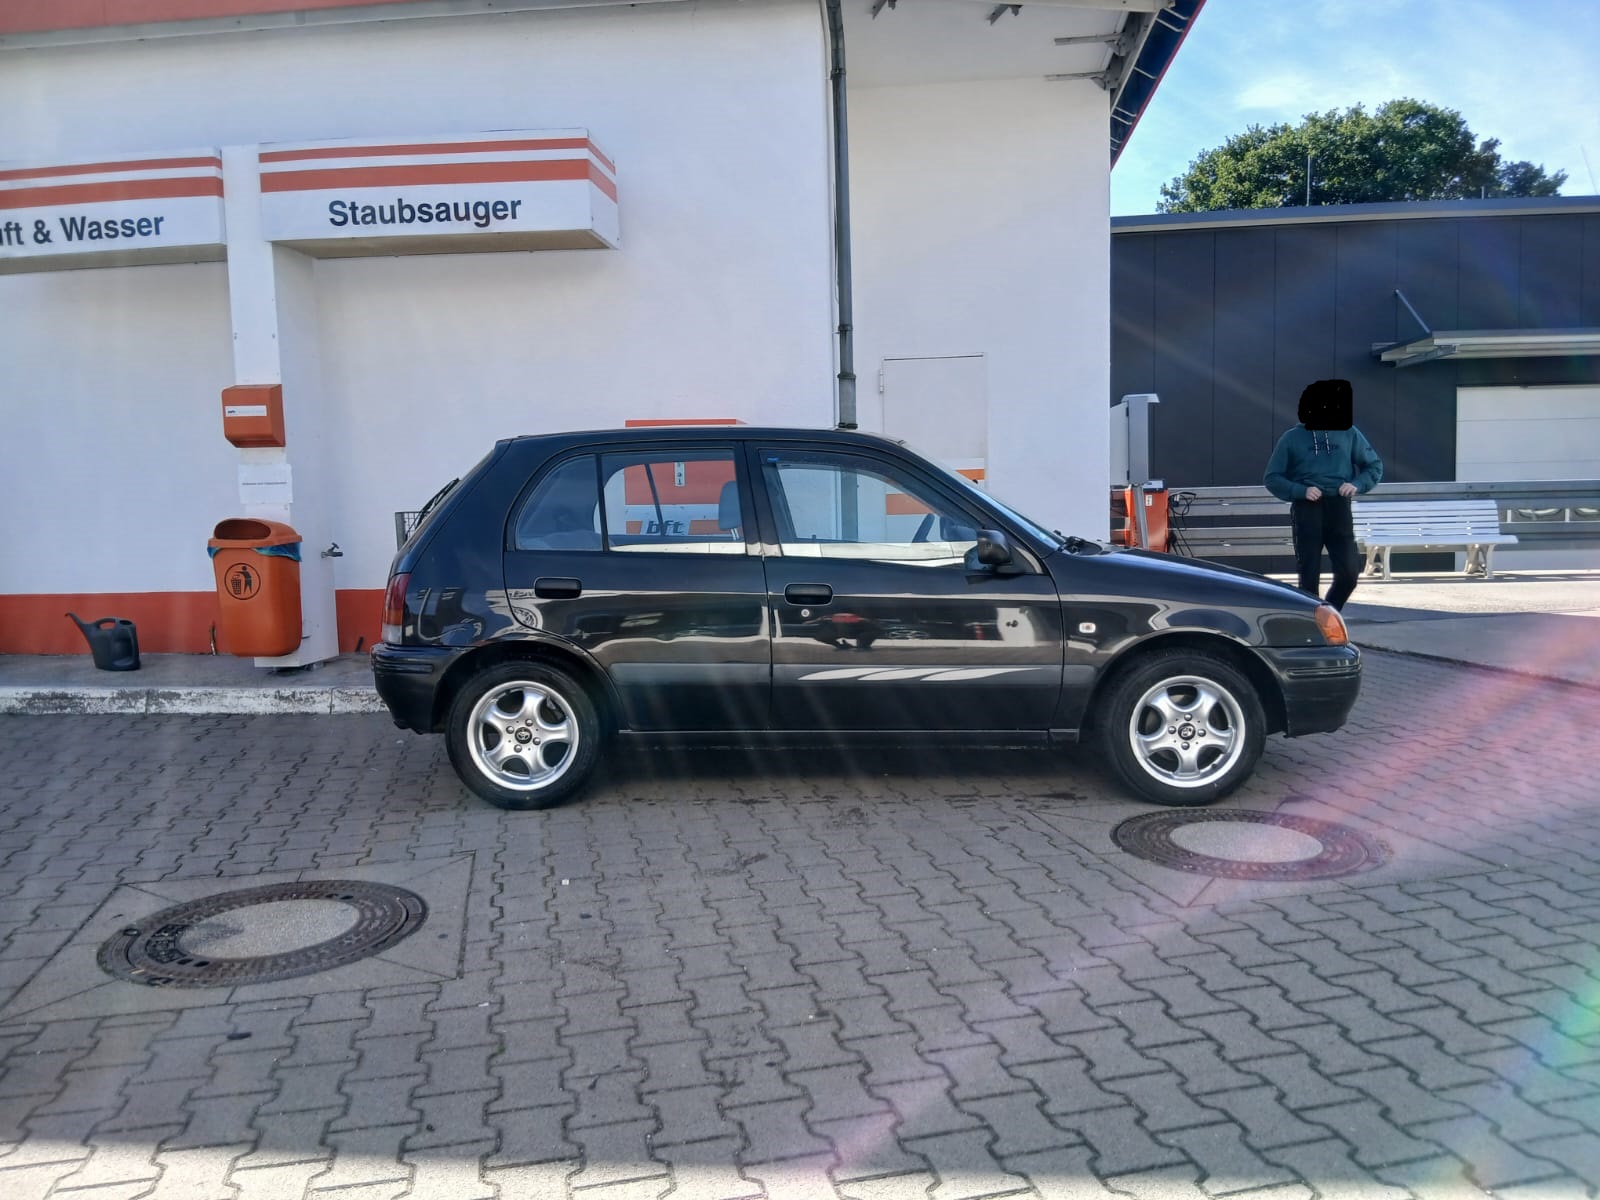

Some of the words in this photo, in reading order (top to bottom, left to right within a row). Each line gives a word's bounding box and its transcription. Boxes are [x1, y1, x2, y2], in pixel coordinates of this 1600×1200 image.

[328, 198, 522, 228] Staubsauger
[0, 221, 25, 247] ft
[33, 219, 53, 245] &
[59, 215, 165, 242] Wasser
